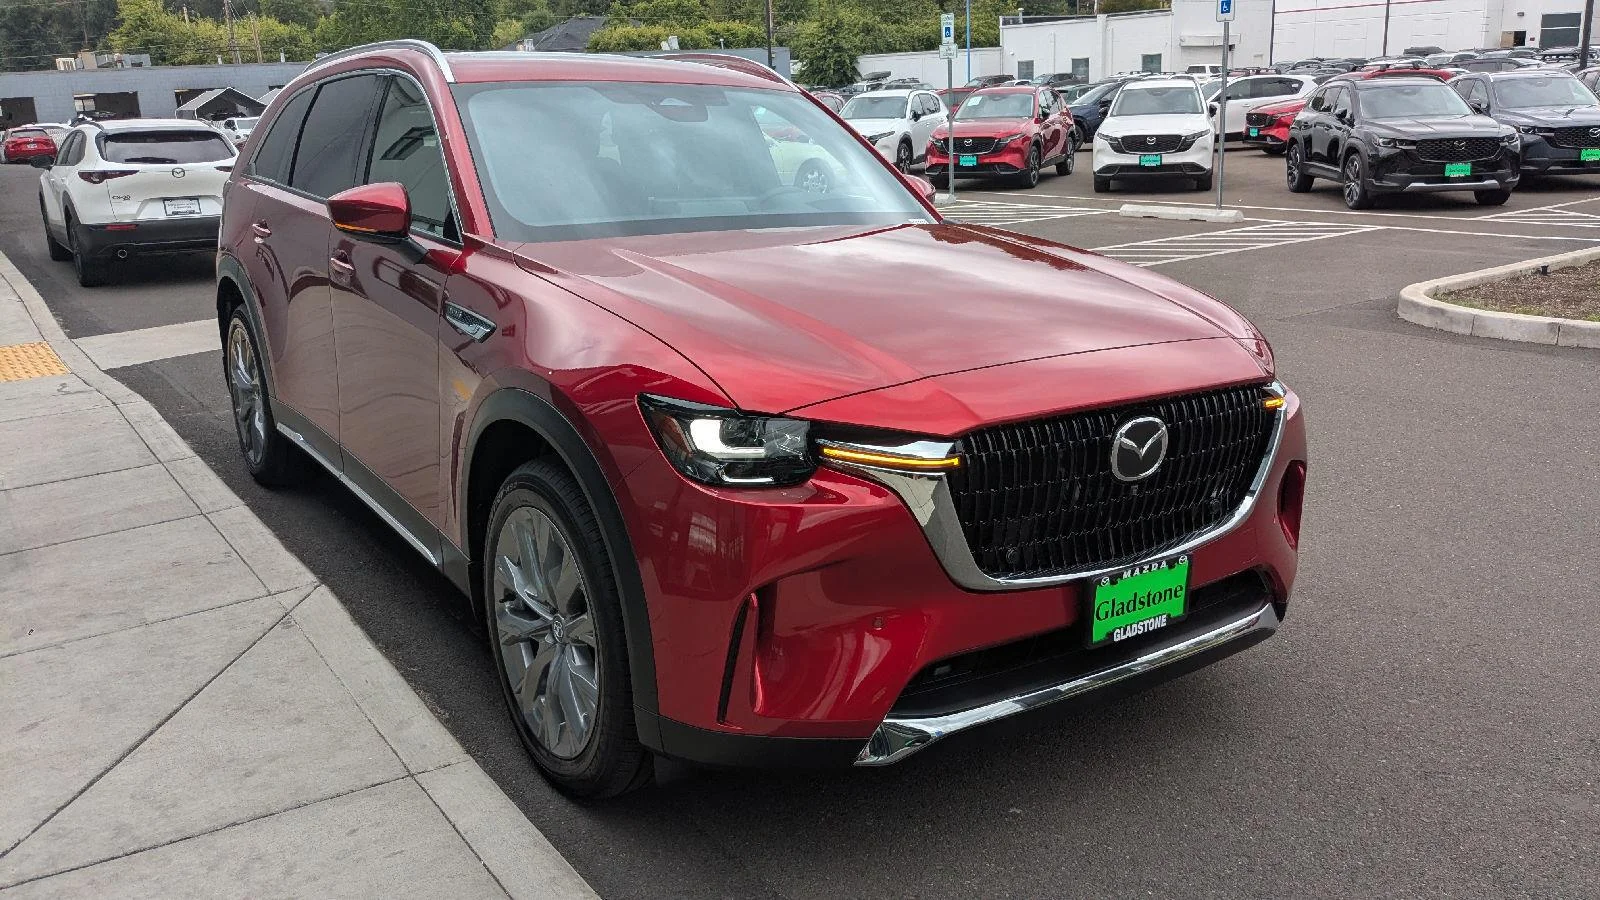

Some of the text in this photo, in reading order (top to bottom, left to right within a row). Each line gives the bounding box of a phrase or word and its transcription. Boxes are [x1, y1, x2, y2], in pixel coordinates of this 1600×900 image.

[1122, 560, 1168, 579] MAZDA
[1095, 584, 1183, 621] Gladstone
[1113, 614, 1167, 642] GLADSTONE
